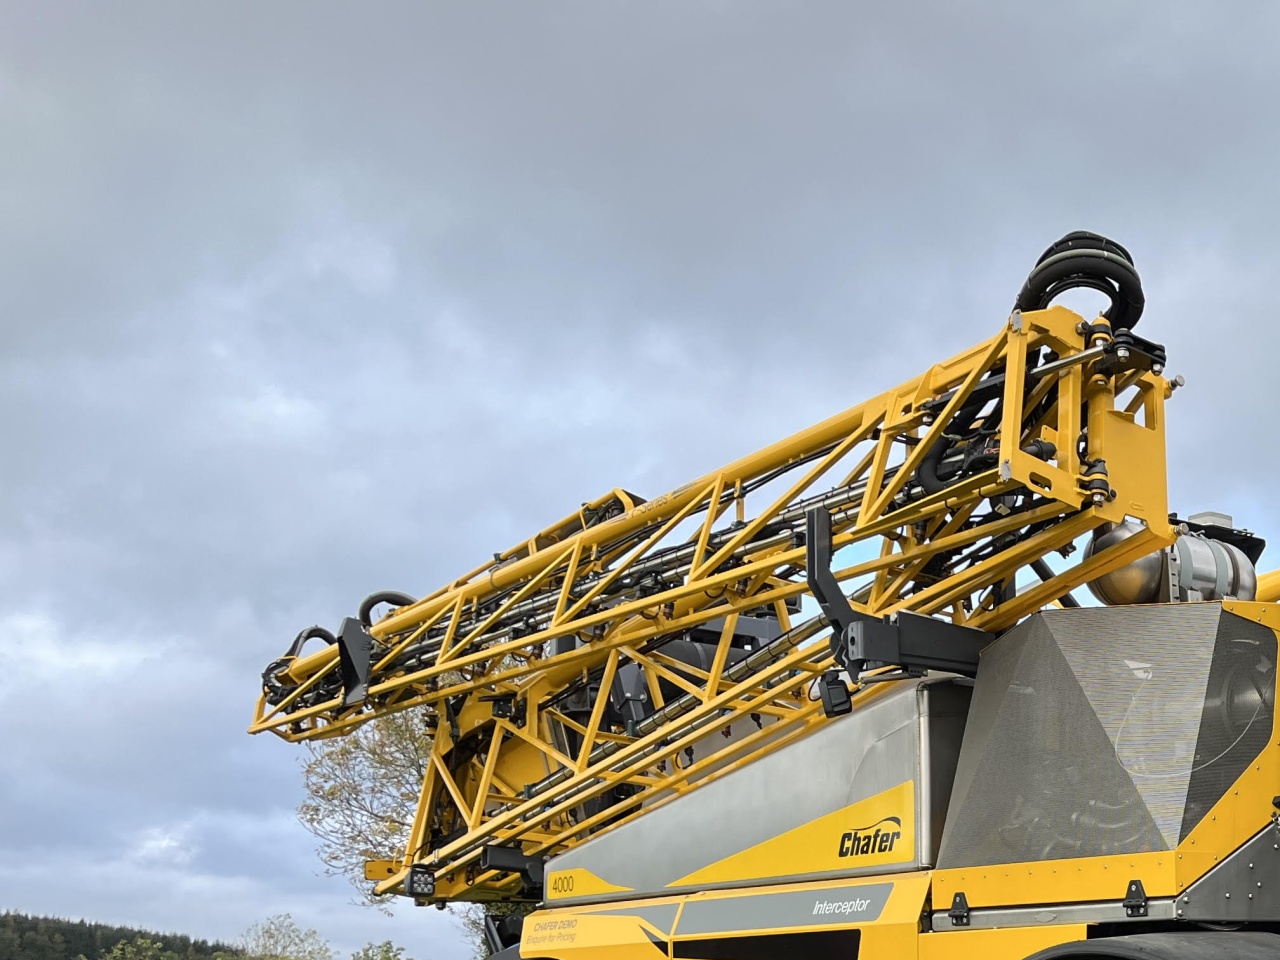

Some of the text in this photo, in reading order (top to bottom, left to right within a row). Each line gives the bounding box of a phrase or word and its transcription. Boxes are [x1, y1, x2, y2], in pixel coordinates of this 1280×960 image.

[839, 823, 901, 858] Chafer
[552, 875, 574, 893] 4000
[812, 897, 871, 916] Interceptor
[534, 918, 578, 932] CHAFER DEMO
